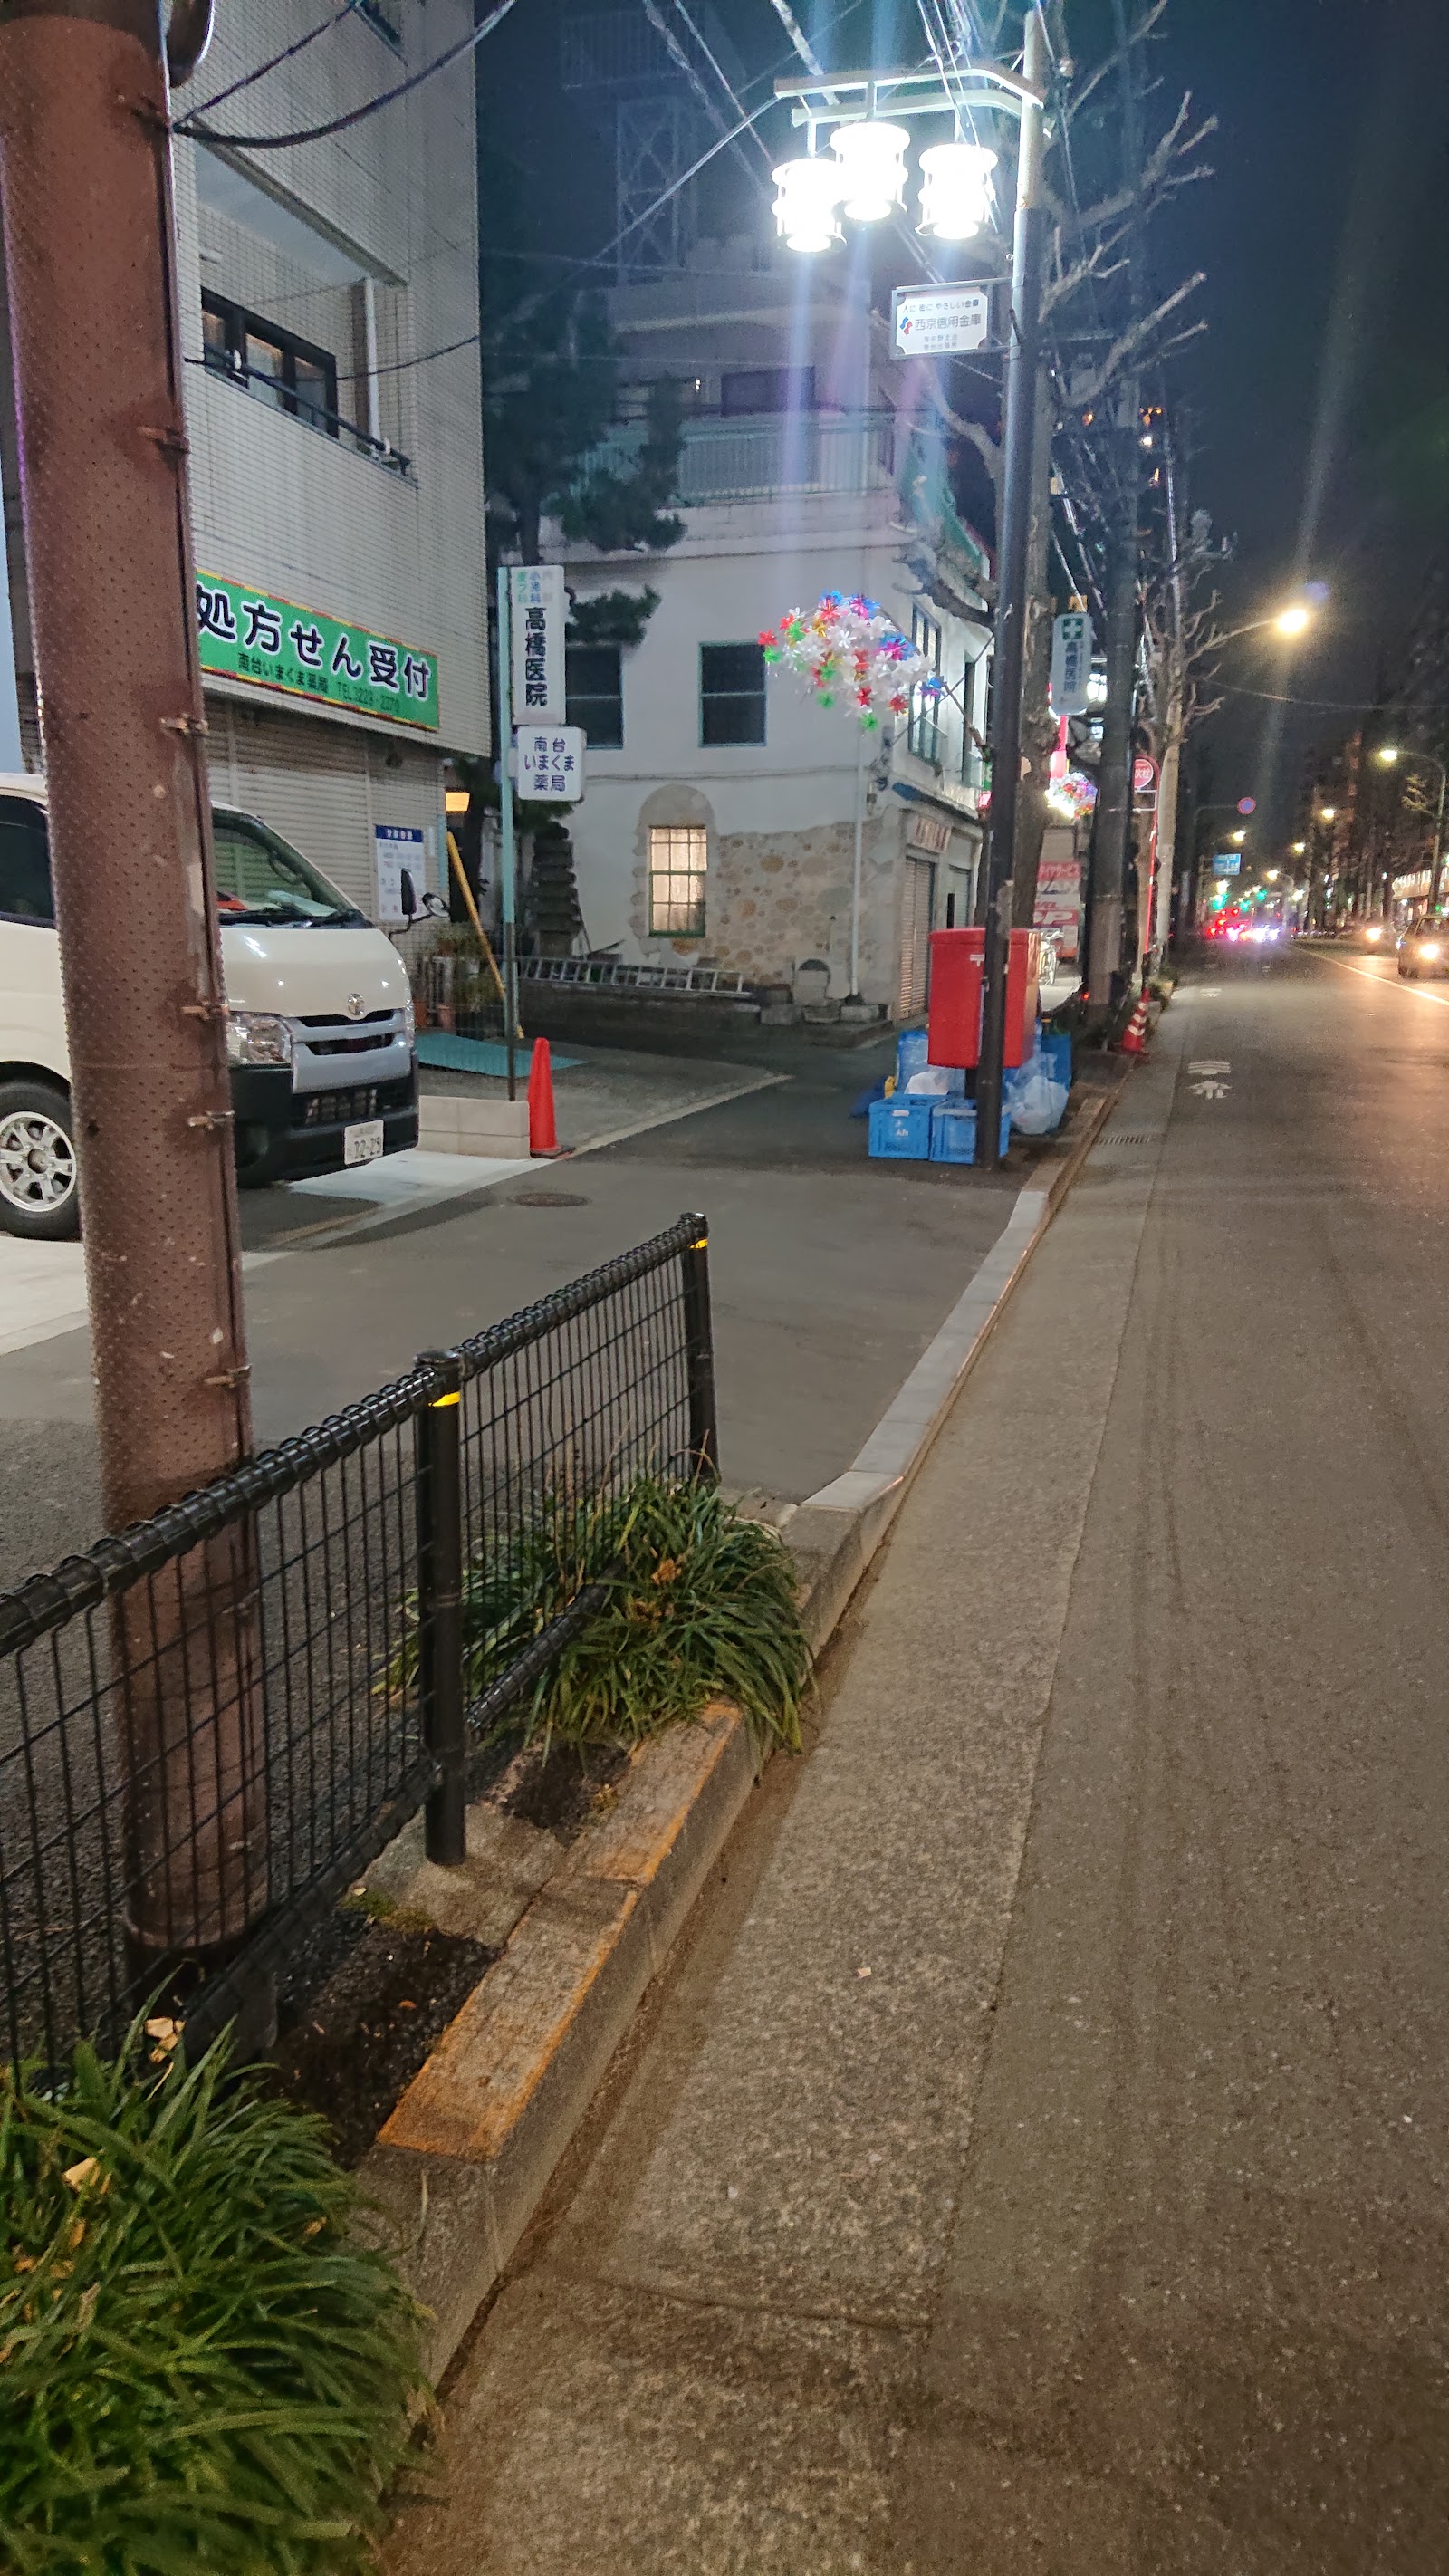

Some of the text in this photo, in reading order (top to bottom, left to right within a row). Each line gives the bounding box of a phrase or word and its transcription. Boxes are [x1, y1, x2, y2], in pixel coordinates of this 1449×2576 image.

[915, 313, 982, 331] 西京信用金庫
[196, 582, 430, 698] 処方せん受付
[524, 606, 548, 706] 高橋医院
[237, 652, 330, 694] 南台いまくま薬局
[533, 735, 566, 753] 南台
[524, 754, 575, 772] いまくま
[1134, 767, 1151, 779] 火栓
[533, 774, 566, 793] 薬局
